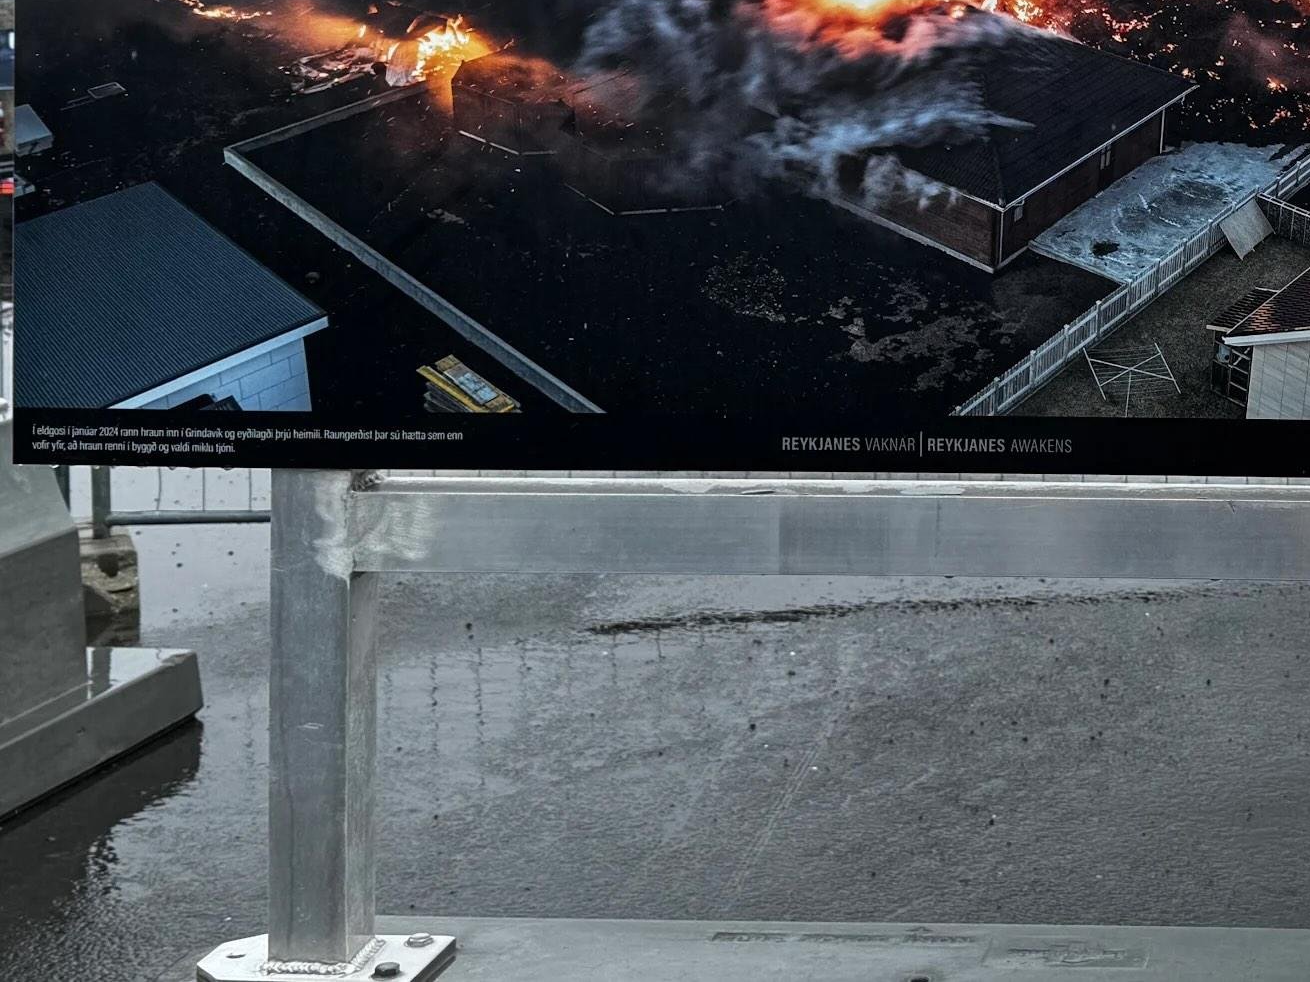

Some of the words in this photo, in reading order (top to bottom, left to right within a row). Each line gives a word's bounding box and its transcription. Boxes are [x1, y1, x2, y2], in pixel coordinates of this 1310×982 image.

[37, 426, 66, 437] eldgosi
[72, 426, 97, 437] janúar
[99, 427, 119, 436] 2024
[120, 428, 138, 437] rann
[141, 427, 164, 437] hraun
[166, 428, 179, 438] inn
[224, 430, 235, 440] og
[237, 428, 273, 440] eyðilagði
[402, 429, 426, 440] hætta
[427, 431, 446, 440] sem
[447, 431, 463, 440] enn
[32, 440, 50, 450] vofir
[80, 440, 103, 451] hraun
[105, 441, 126, 451] renni
[158, 444, 169, 454] og
[171, 442, 190, 452] valdi
[192, 442, 214, 453] miklu
[782, 437, 860, 451] REYKJANES
[865, 437, 916, 452] VAKNAR
[927, 438, 1005, 452] REYKJANES
[1010, 439, 1073, 454] AWAKENS
